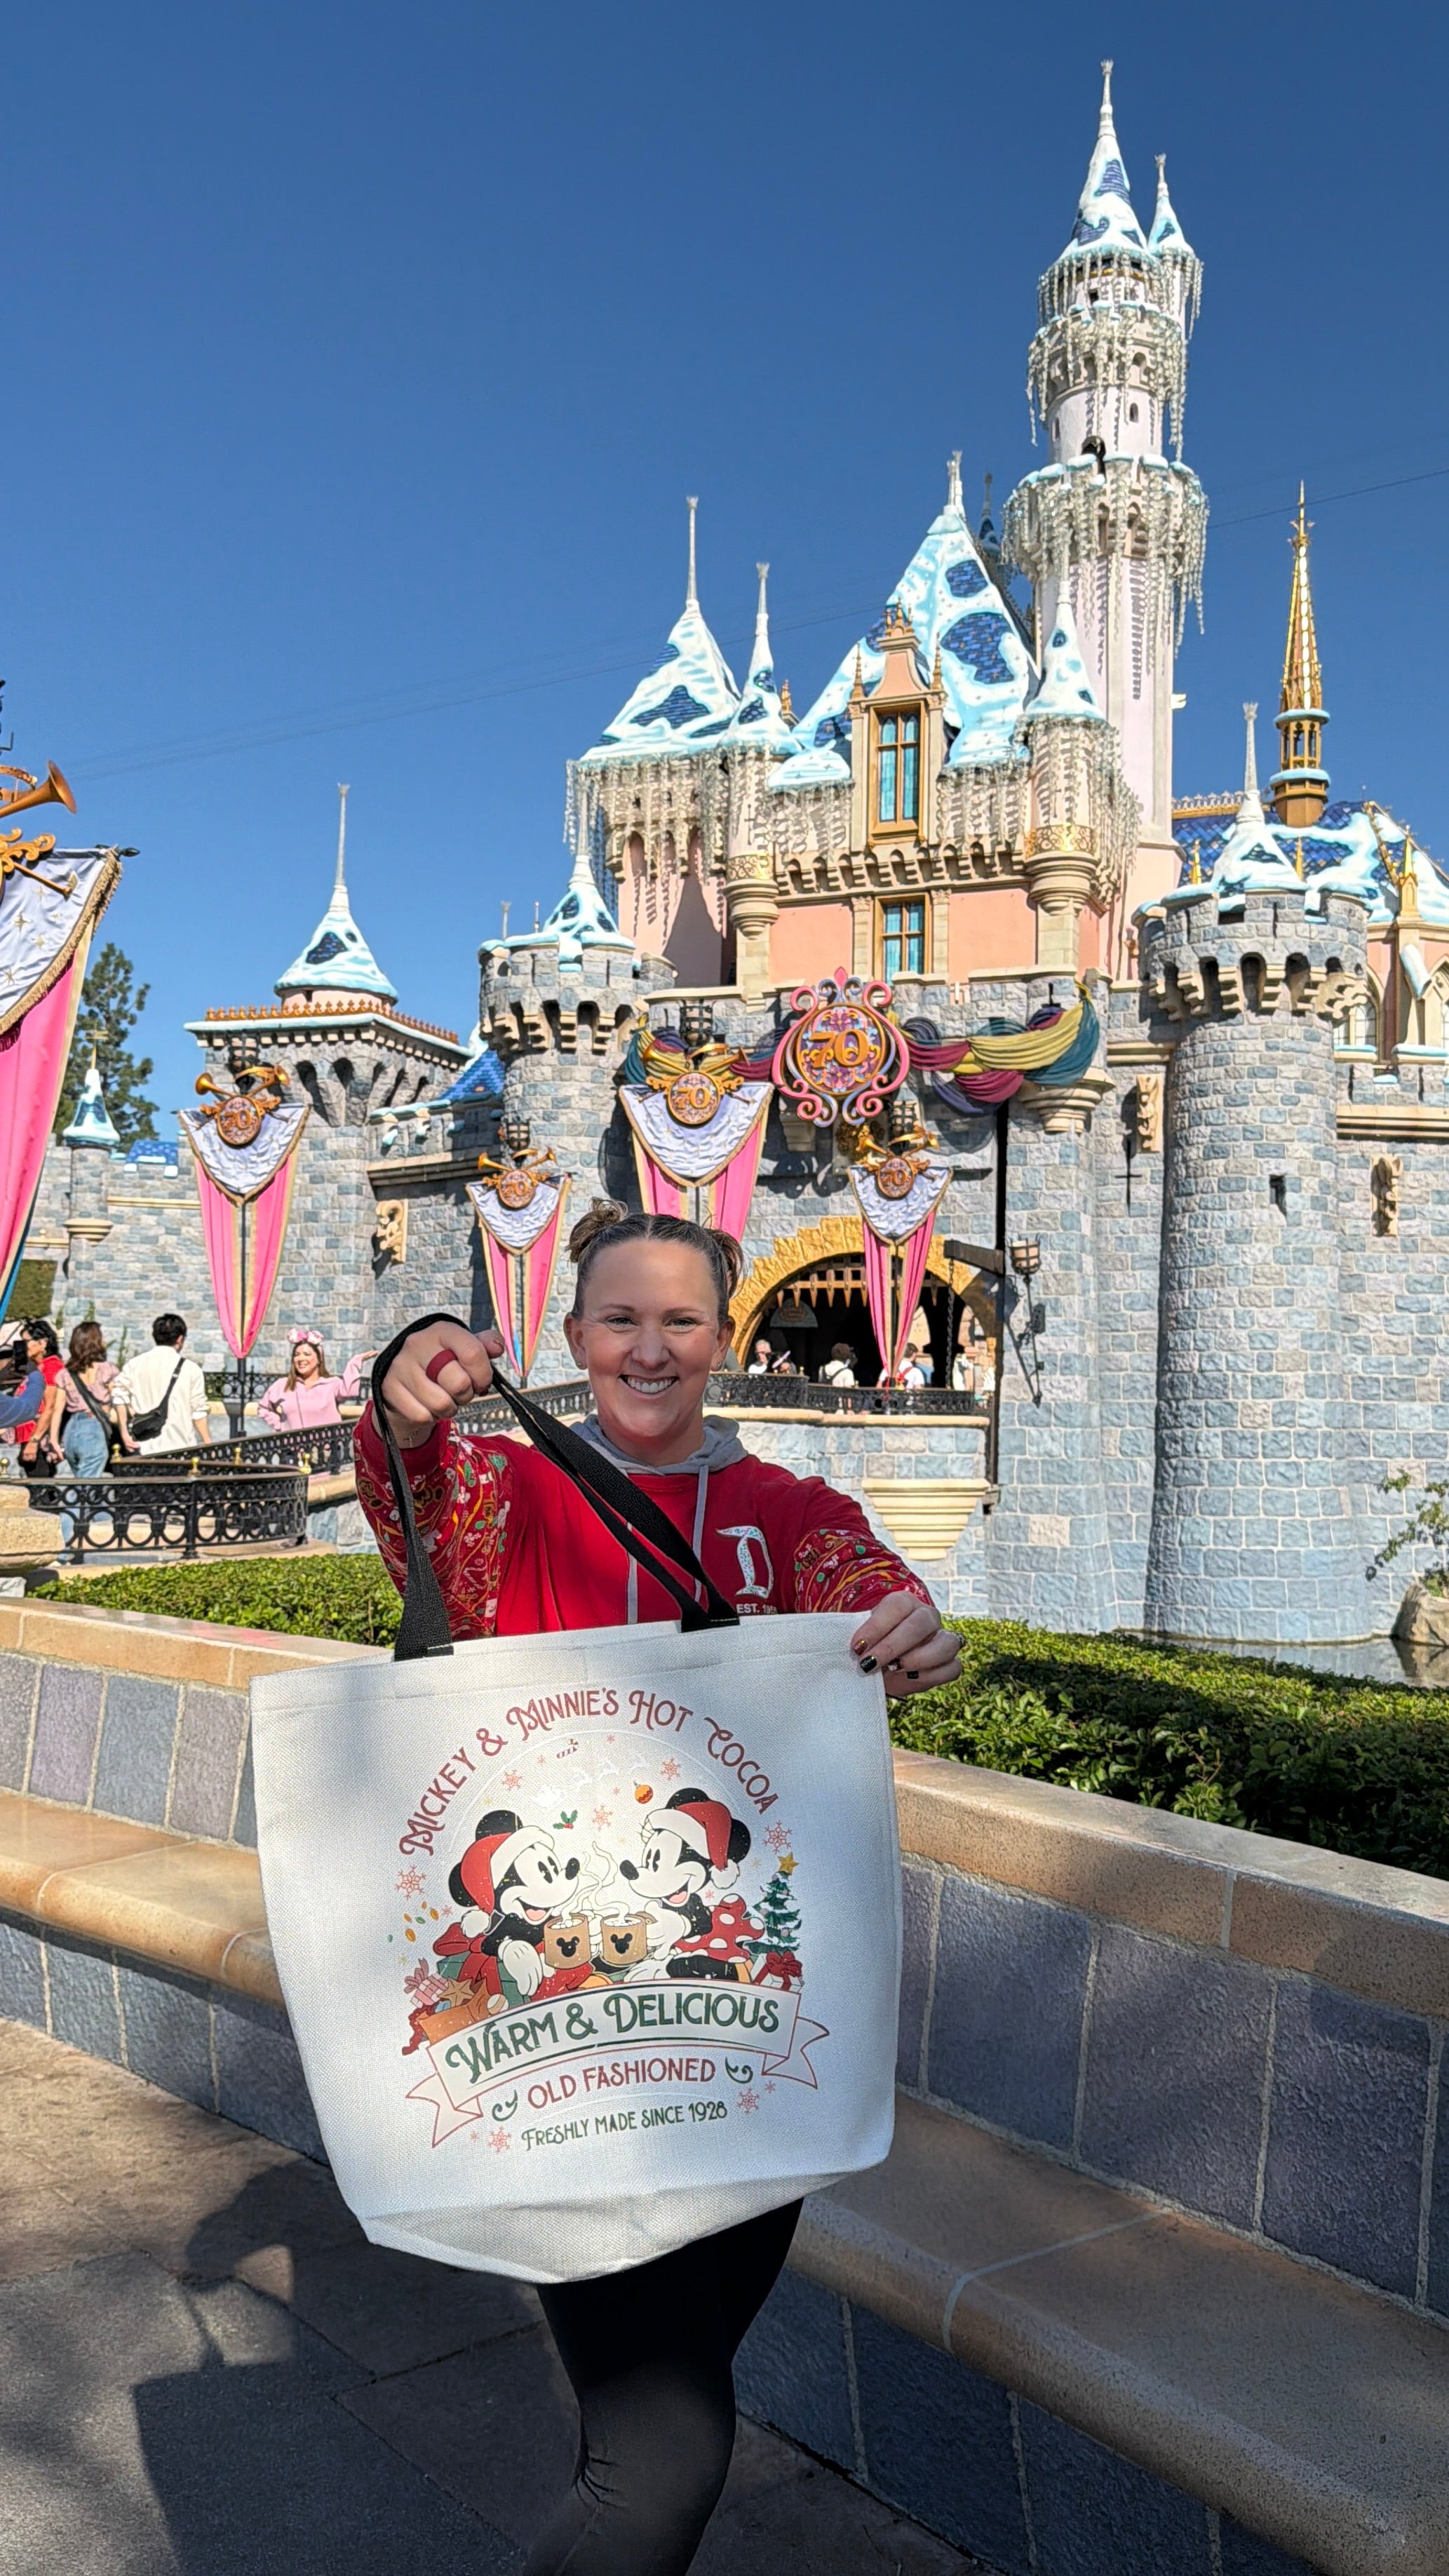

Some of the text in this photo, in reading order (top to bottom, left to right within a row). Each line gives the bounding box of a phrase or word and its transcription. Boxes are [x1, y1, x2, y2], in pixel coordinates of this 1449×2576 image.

[809, 1028, 870, 1069] 70
[677, 1087, 710, 1109] 70
[224, 1110, 252, 1133] 70
[883, 1169, 907, 1187] 70
[736, 1603, 760, 1614] EST.
[399, 1687, 779, 1856] MICKEY & MINNIE'S HOT COCOA
[445, 1992, 779, 2084] WARM & DELICIOUS
[527, 2058, 716, 2109] OLD FASHIONED
[520, 2100, 727, 2152] FRESHLY MADE SINCE 1928
